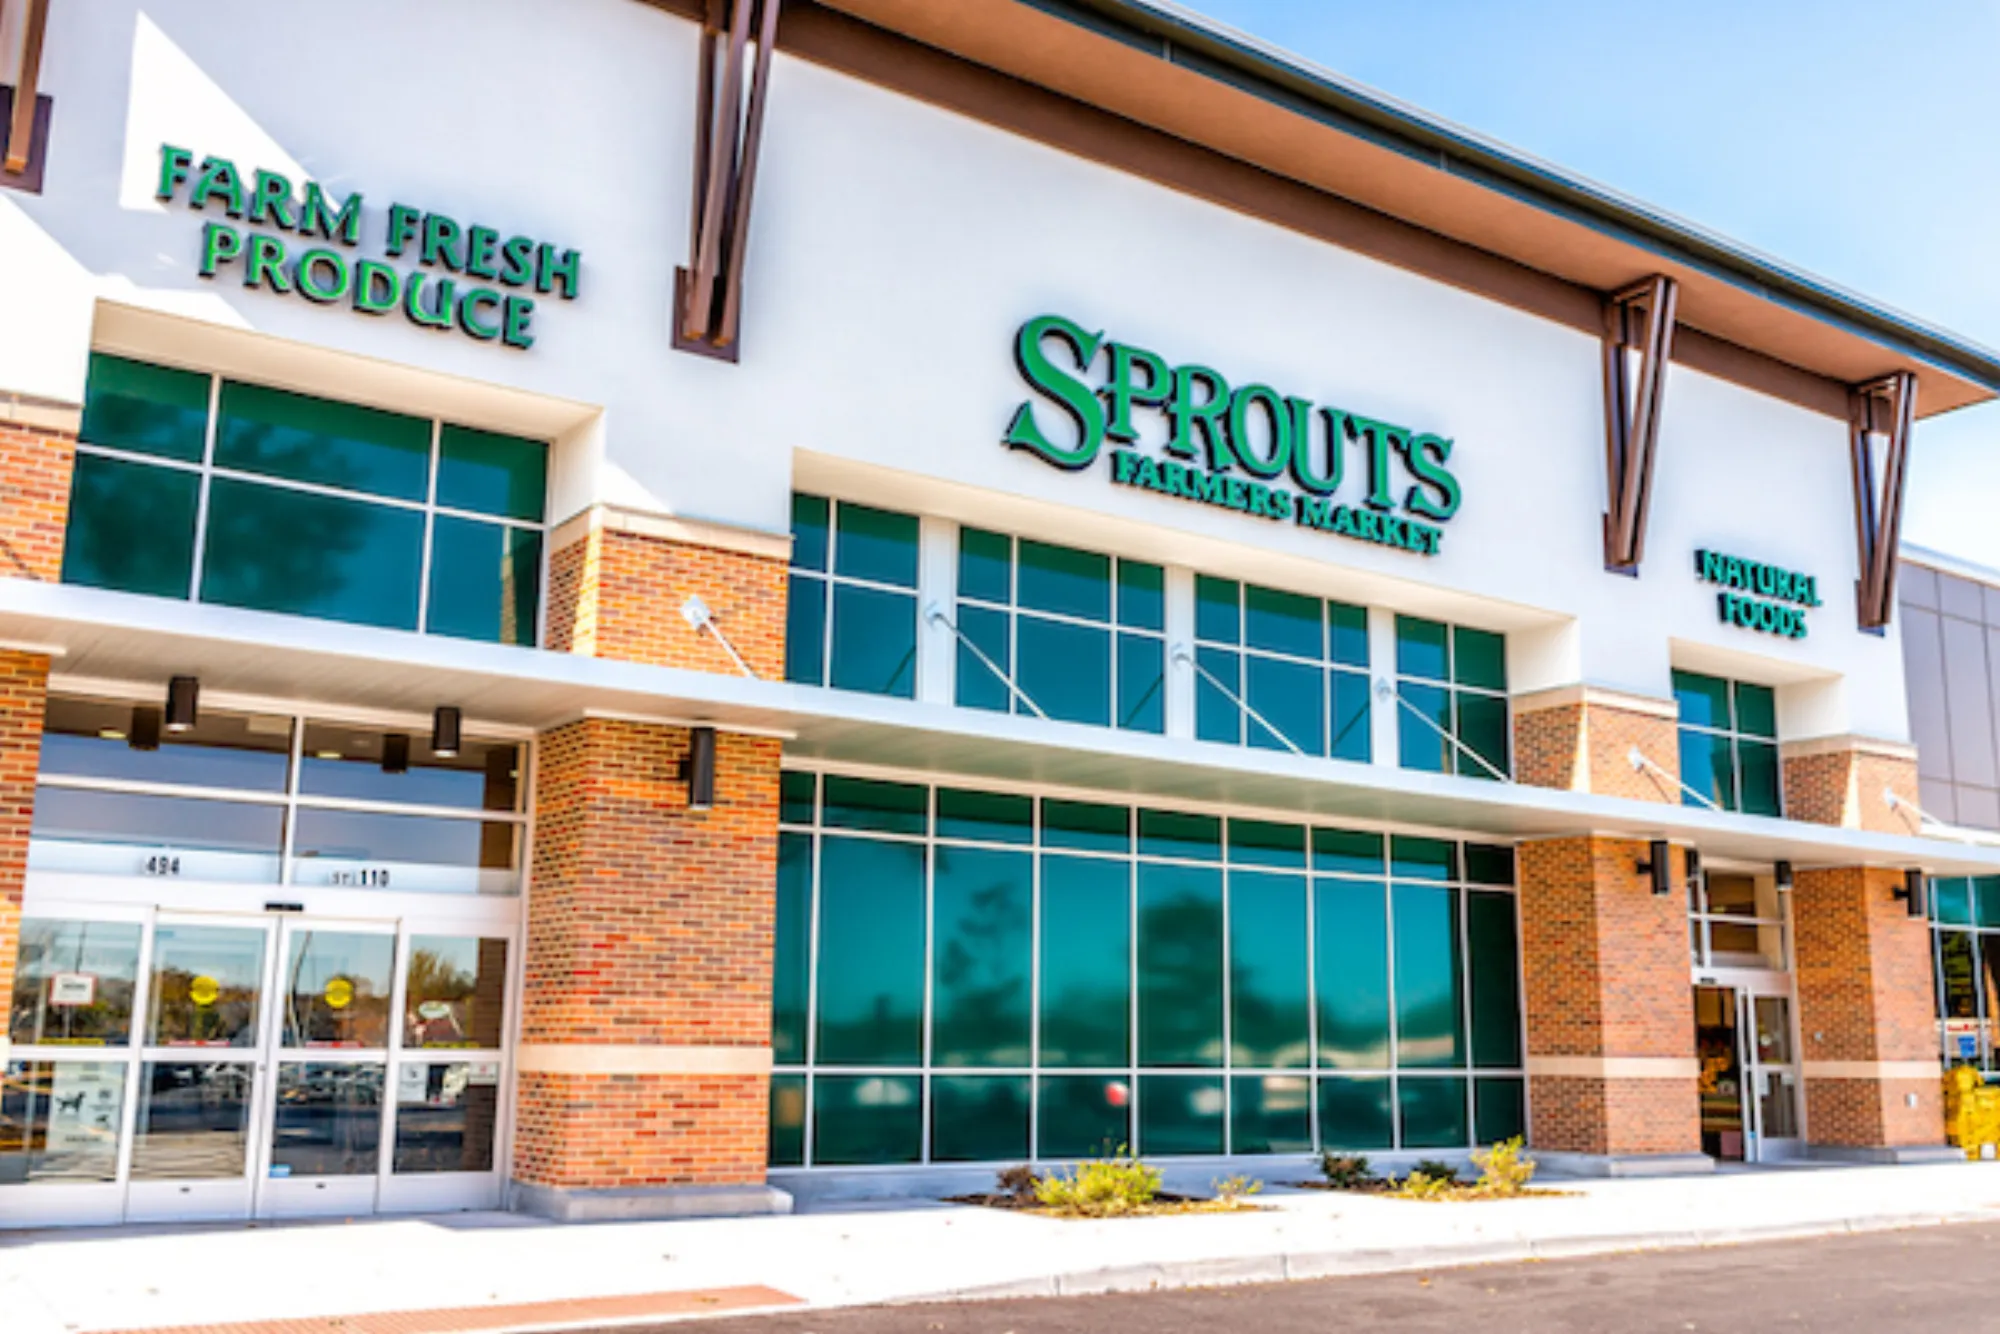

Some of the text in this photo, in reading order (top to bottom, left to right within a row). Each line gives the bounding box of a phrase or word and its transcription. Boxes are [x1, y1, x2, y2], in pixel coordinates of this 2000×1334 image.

[156, 143, 580, 300] FARM FRESH
[199, 221, 536, 349] PRODUCE
[1001, 315, 1462, 521] SPROUTS
[1109, 450, 1443, 555] FARMERS MARKET
[1694, 549, 1823, 607] NATURAL
[1717, 593, 1808, 639] FOODS
[147, 856, 181, 875] 494
